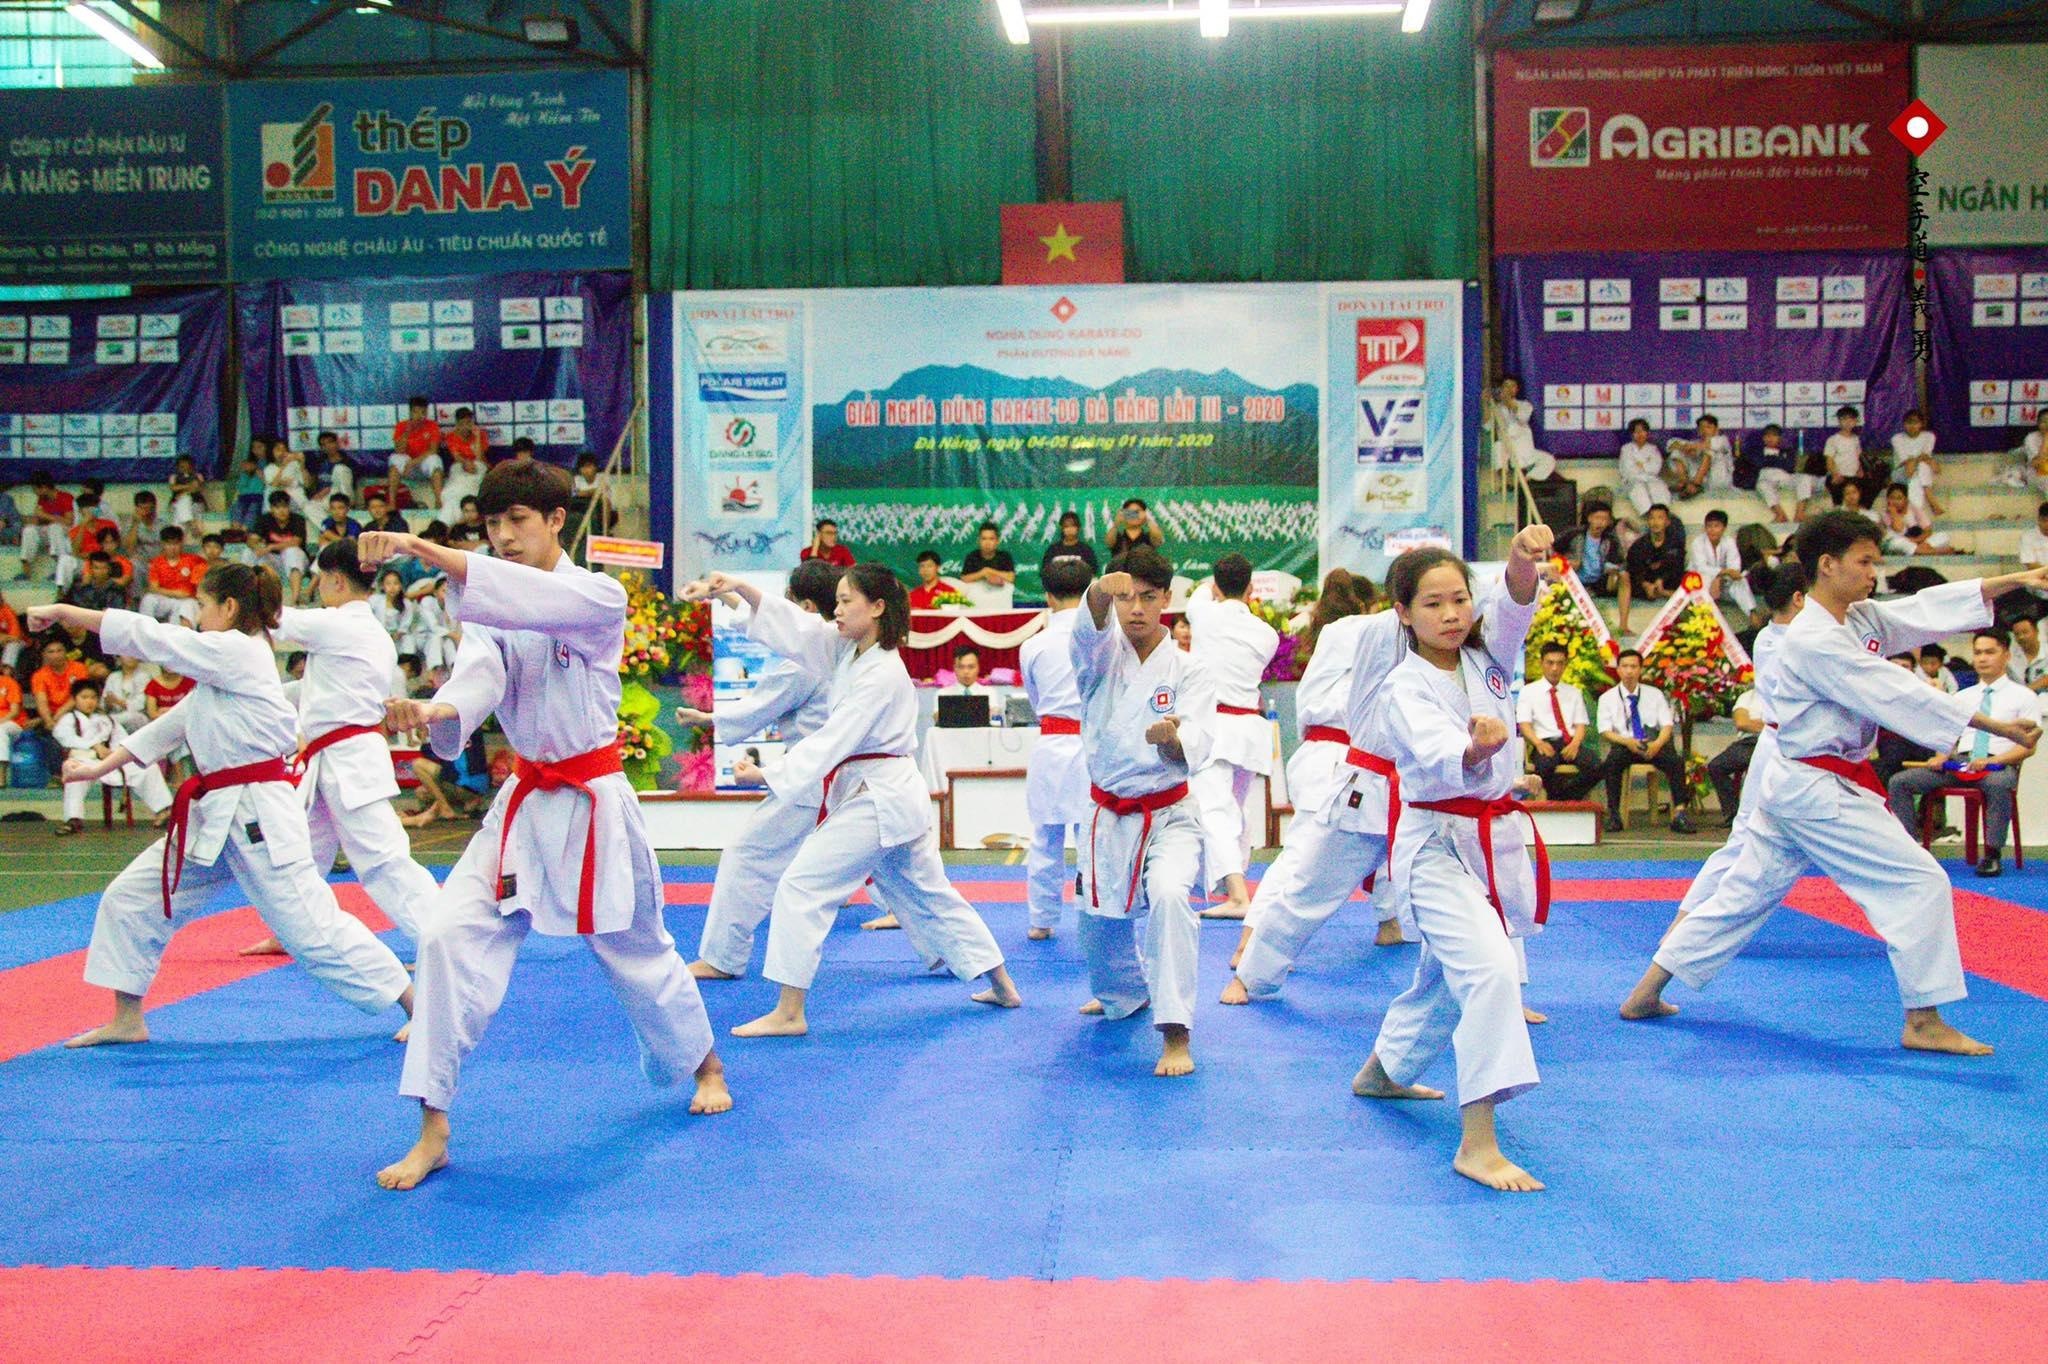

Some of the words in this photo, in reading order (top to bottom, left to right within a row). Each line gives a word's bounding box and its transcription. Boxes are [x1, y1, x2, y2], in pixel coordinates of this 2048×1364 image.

[352, 106, 471, 160] thép
[147, 164, 212, 192] TRUNG
[353, 145, 597, 217] DANA-Ý
[1938, 178, 2020, 212] NGÂN
[1244, 394, 1286, 423] 2020
[1176, 433, 1215, 447] 2020
